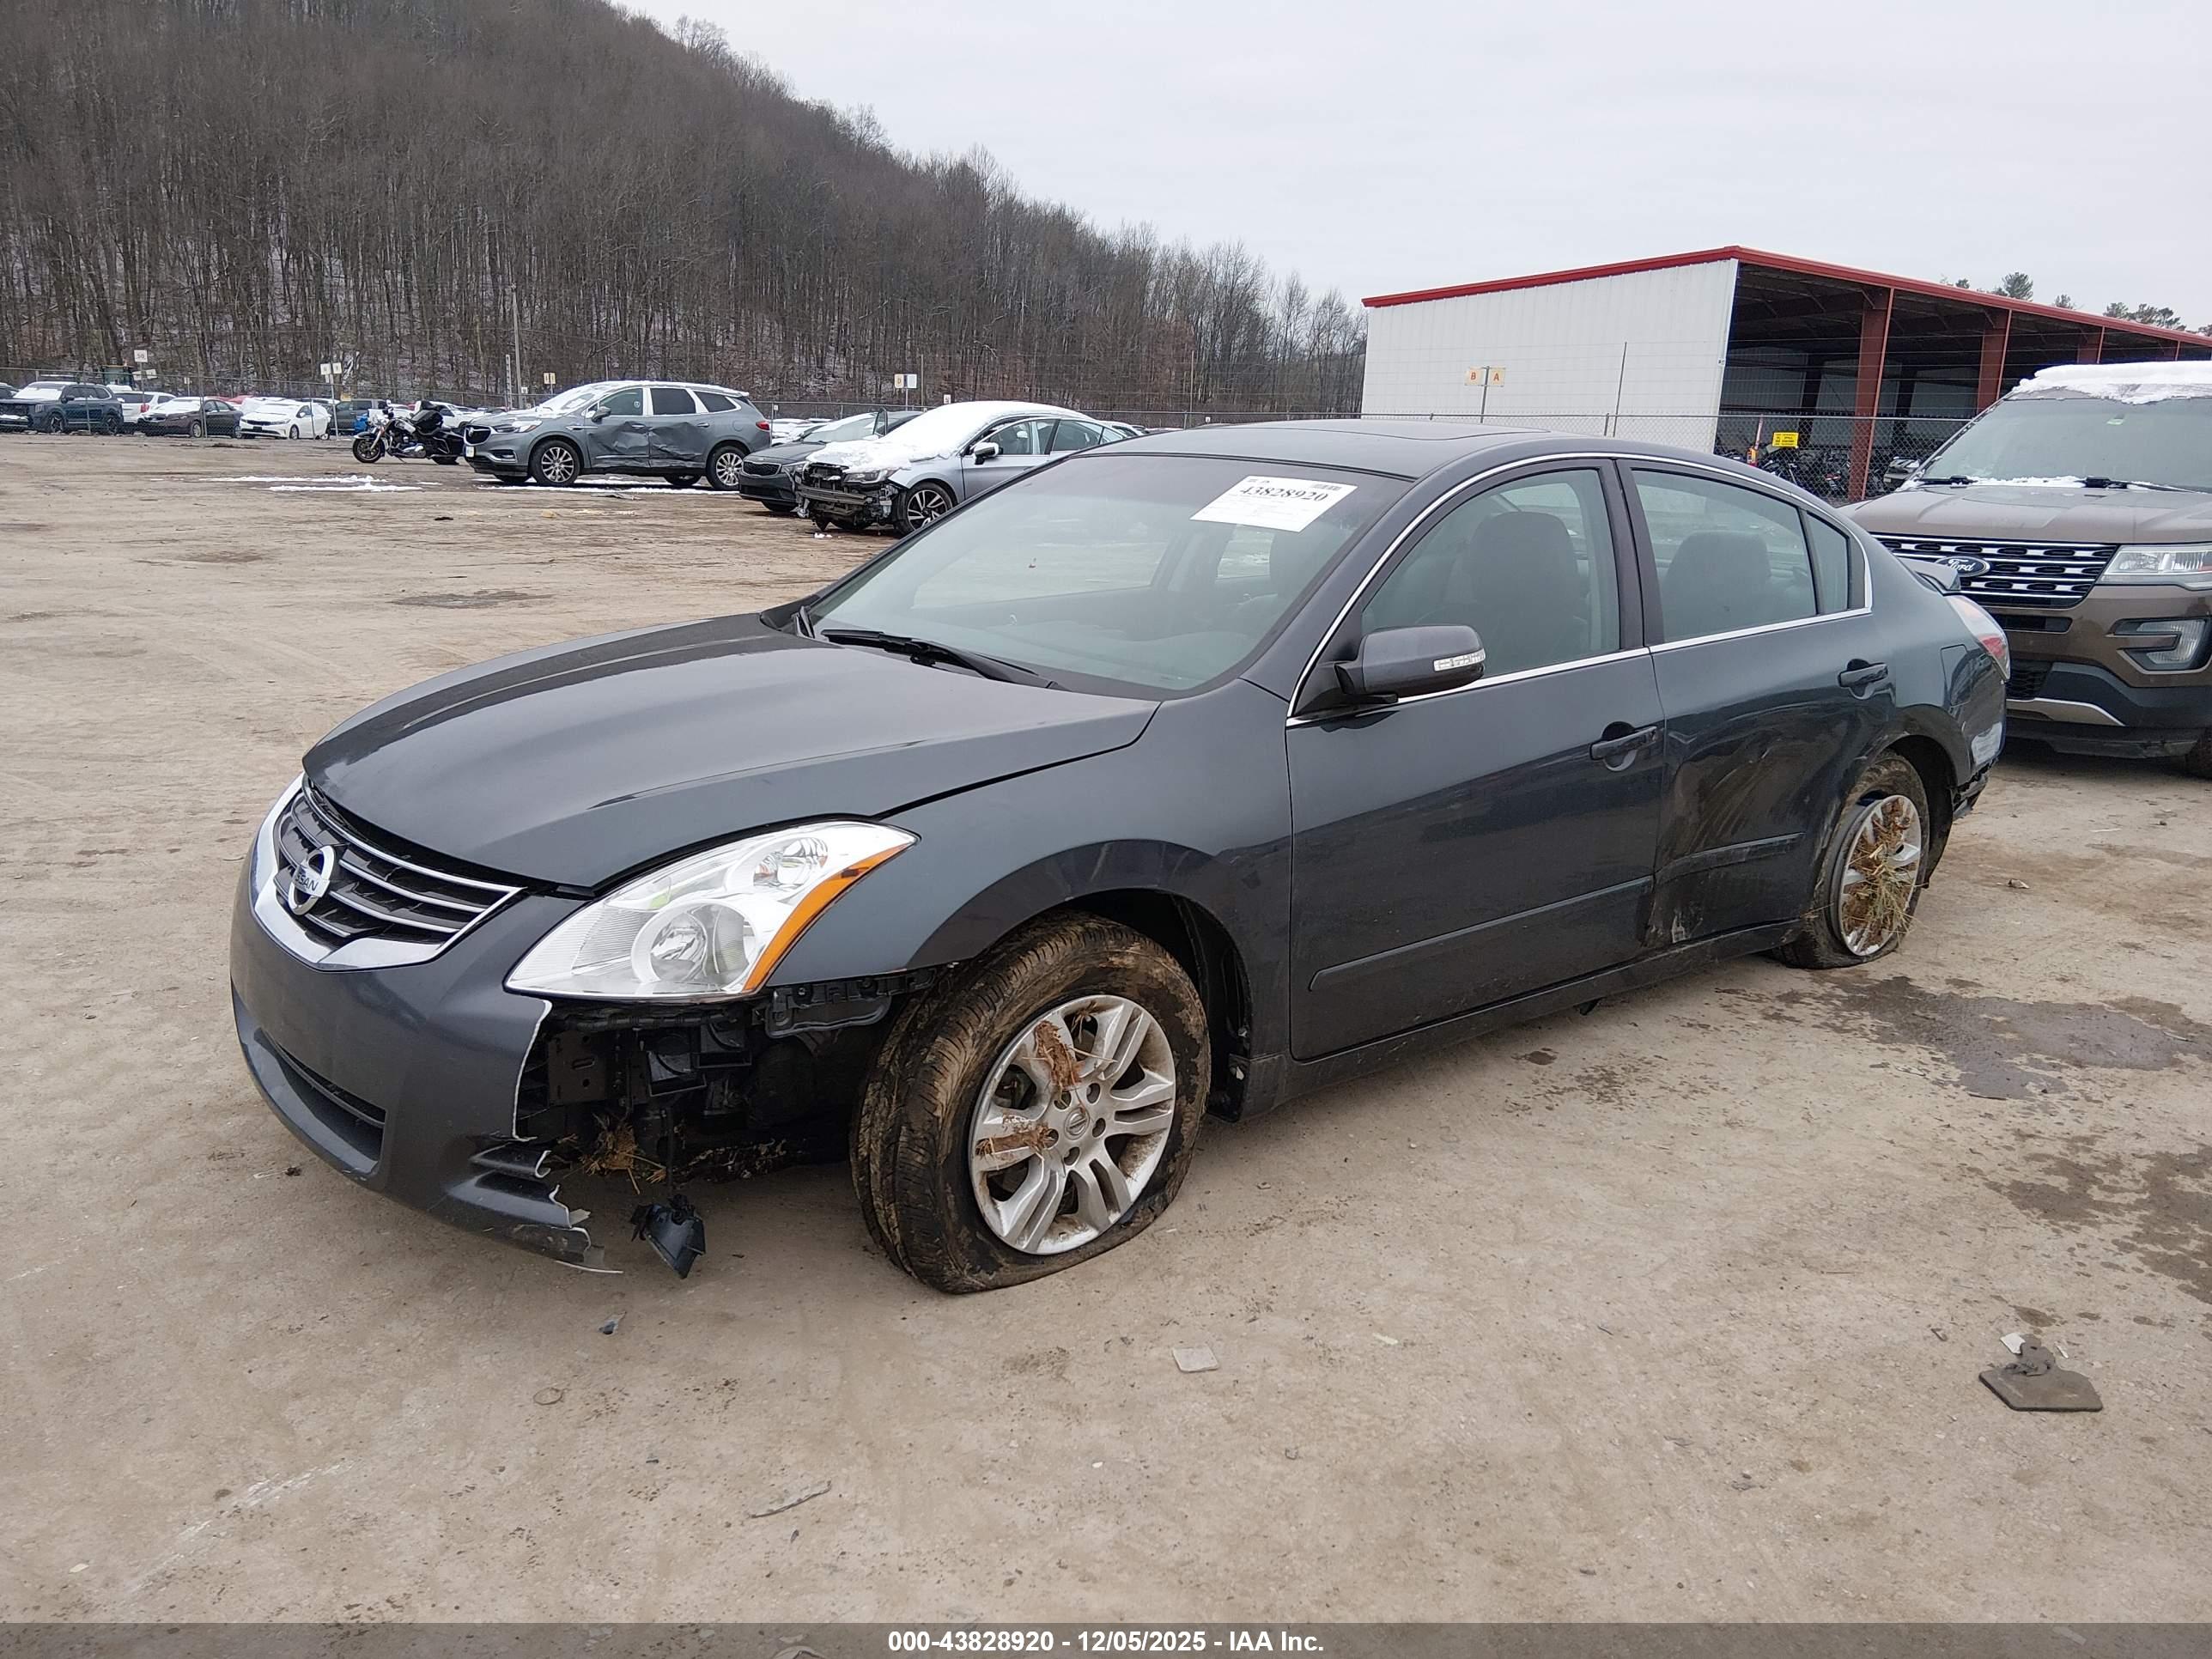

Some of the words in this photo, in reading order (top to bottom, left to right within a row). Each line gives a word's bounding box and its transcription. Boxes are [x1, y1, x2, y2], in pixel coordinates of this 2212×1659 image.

[1470, 372, 1476, 380] B
[1493, 373, 1499, 381] A
[1240, 486, 1329, 501] 43828920
